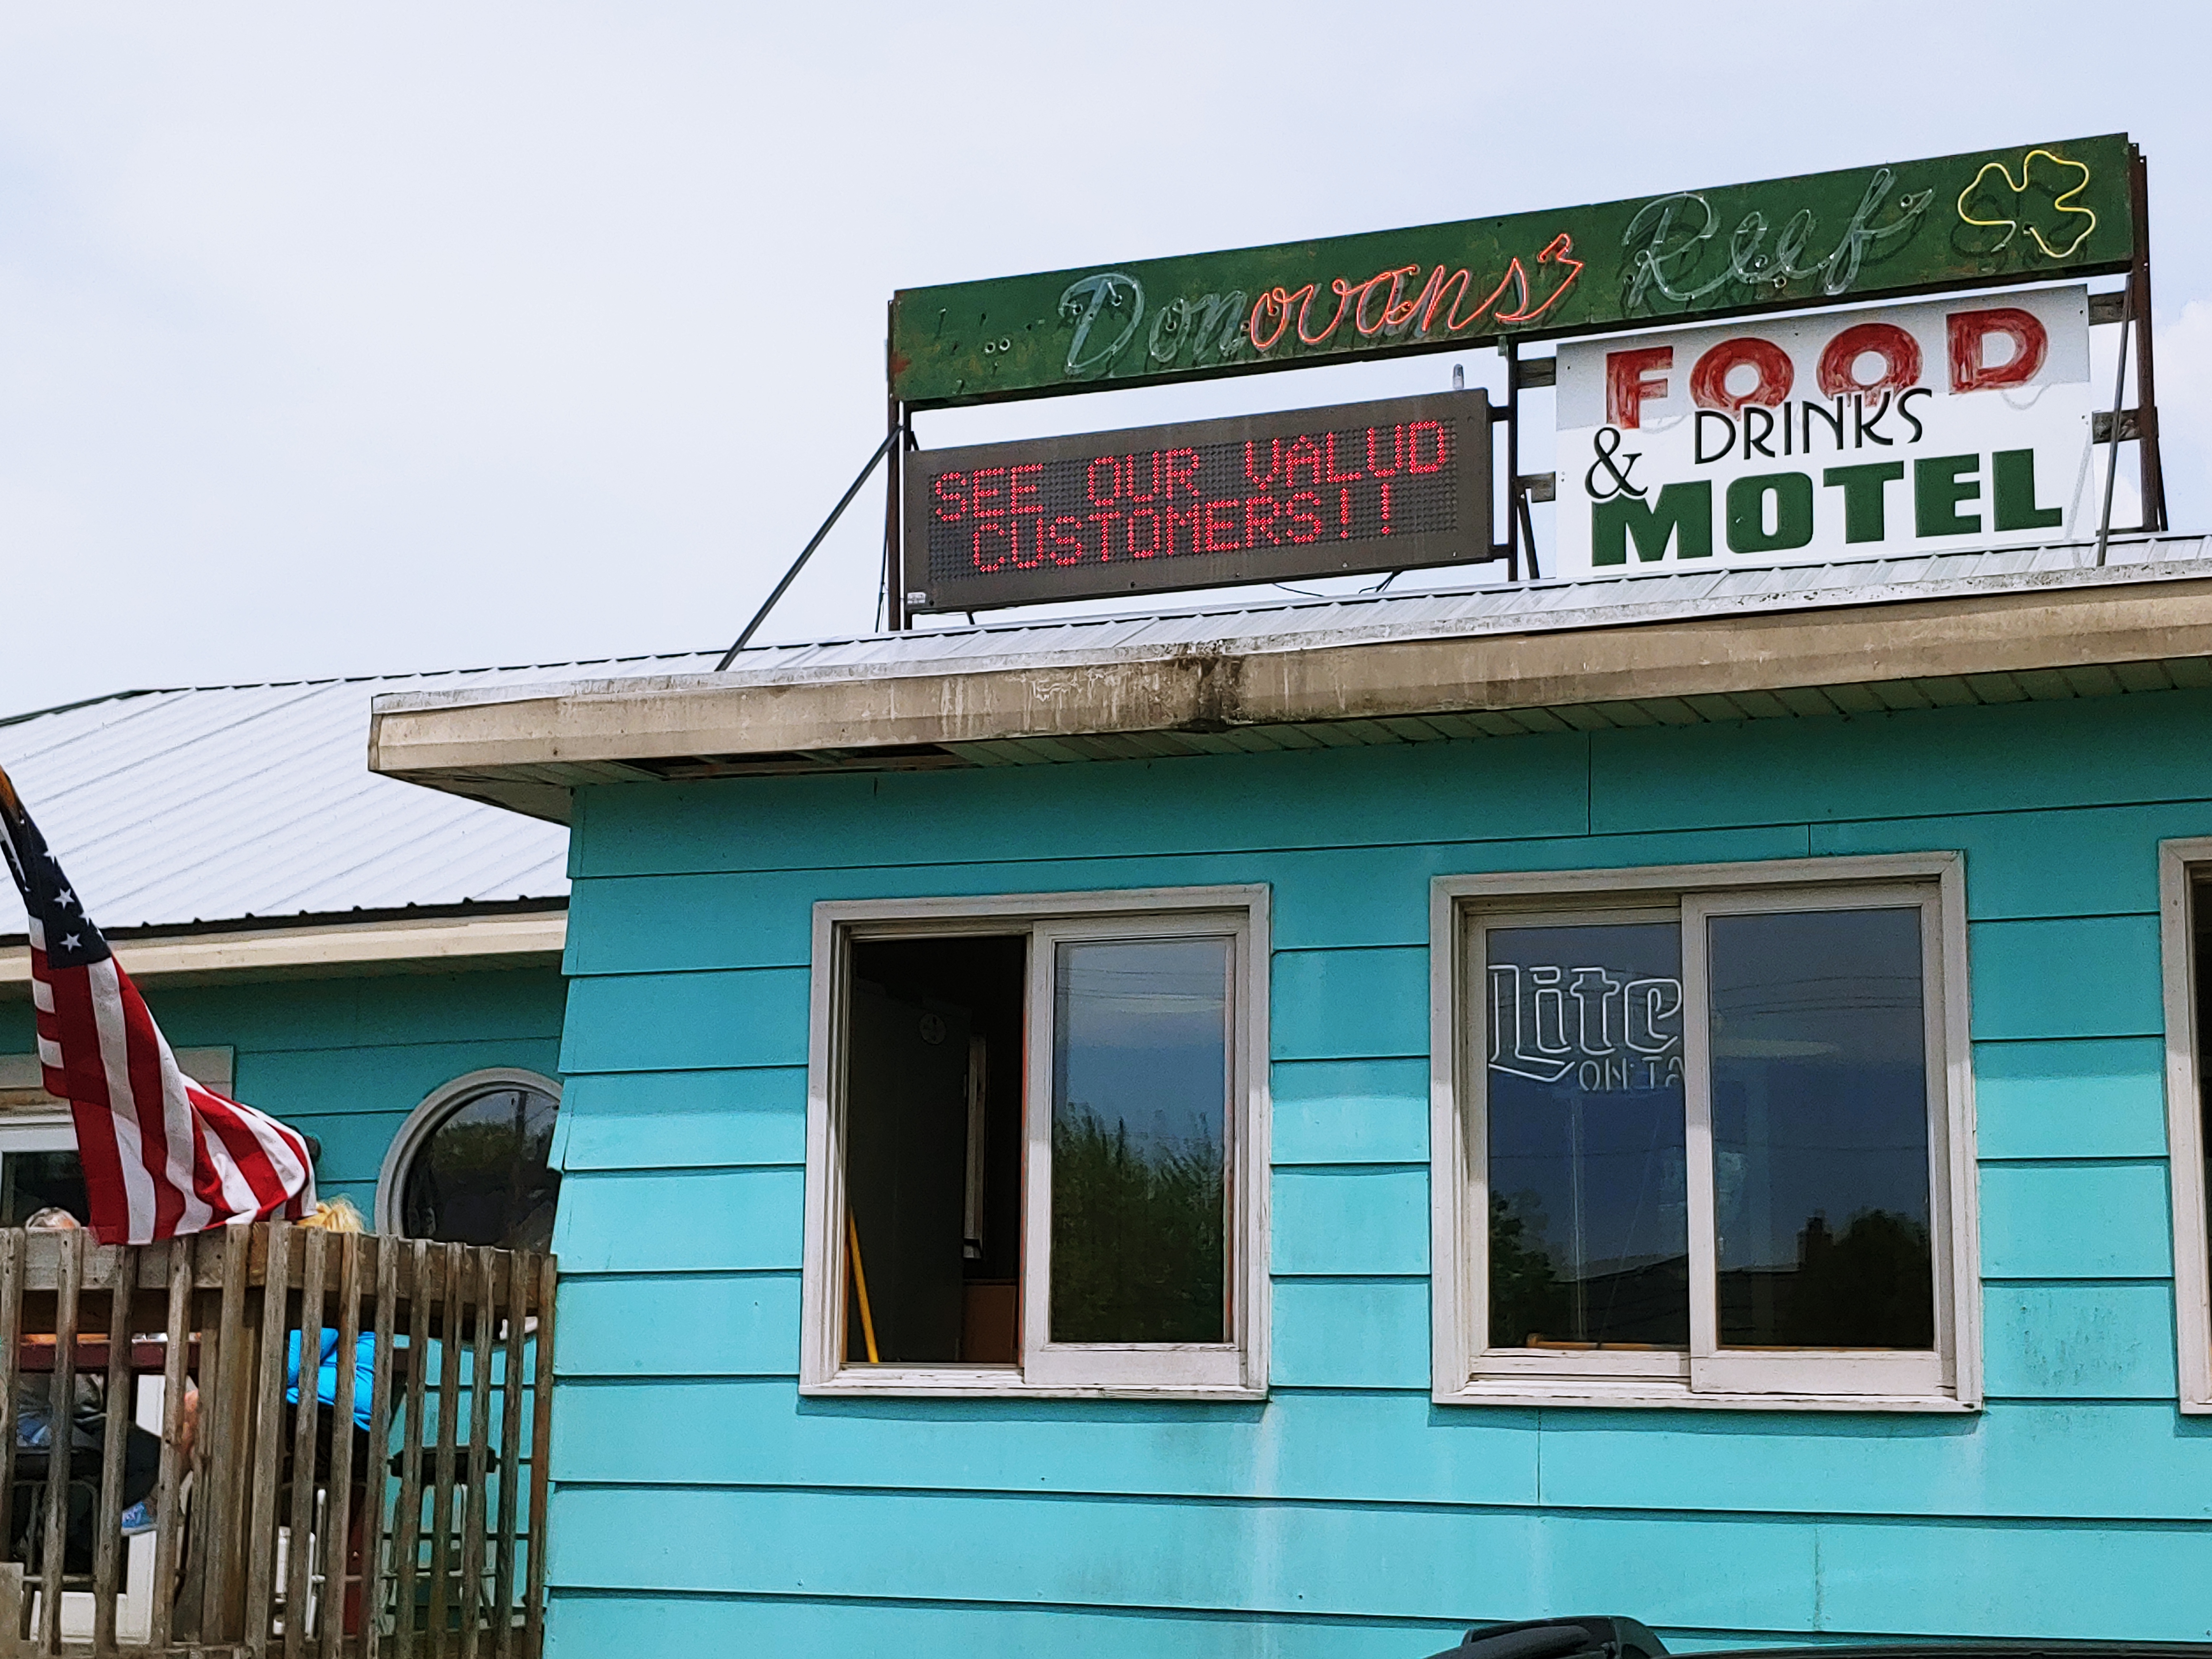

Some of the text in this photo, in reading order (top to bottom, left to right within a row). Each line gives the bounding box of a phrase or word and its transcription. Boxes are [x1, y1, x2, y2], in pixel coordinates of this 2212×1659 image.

[1621, 167, 1934, 309] Reef
[1606, 307, 2049, 429] FOOD
[934, 420, 1446, 522] SEE OUR VALUD
[1584, 426, 1649, 501] &
[1694, 387, 1933, 465] DRINKS
[1591, 447, 2063, 568] MOTEL
[1487, 963, 1683, 1083] Lite
[1578, 1055, 1686, 1091] ON TA
